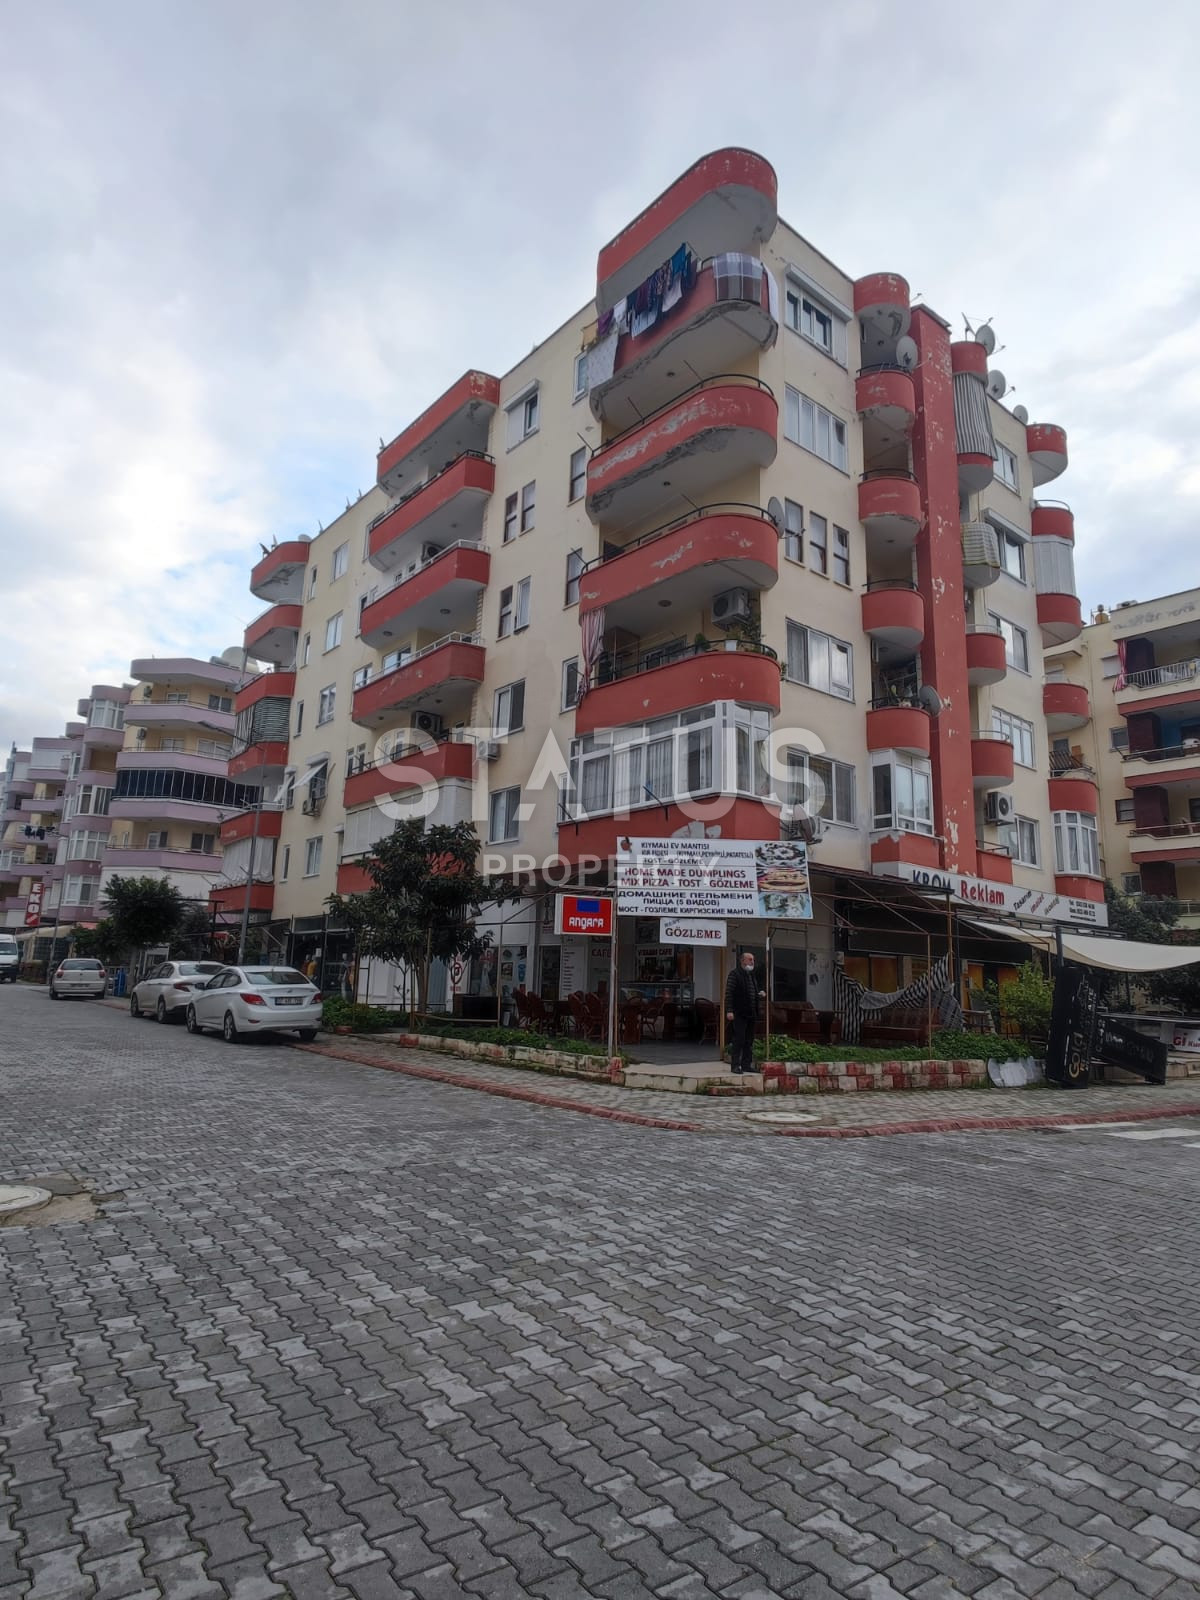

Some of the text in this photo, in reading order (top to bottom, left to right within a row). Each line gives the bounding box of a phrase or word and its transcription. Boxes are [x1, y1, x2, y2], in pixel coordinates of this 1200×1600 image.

[624, 868, 746, 878] HOME MADE DUMPLINGS
[621, 878, 640, 886] MIX
[642, 878, 669, 887] PIZZA
[678, 879, 701, 887] TOST
[709, 878, 755, 888] GÖZLEME
[960, 879, 1005, 905] Reklam
[665, 926, 722, 939] GÖZLEME
